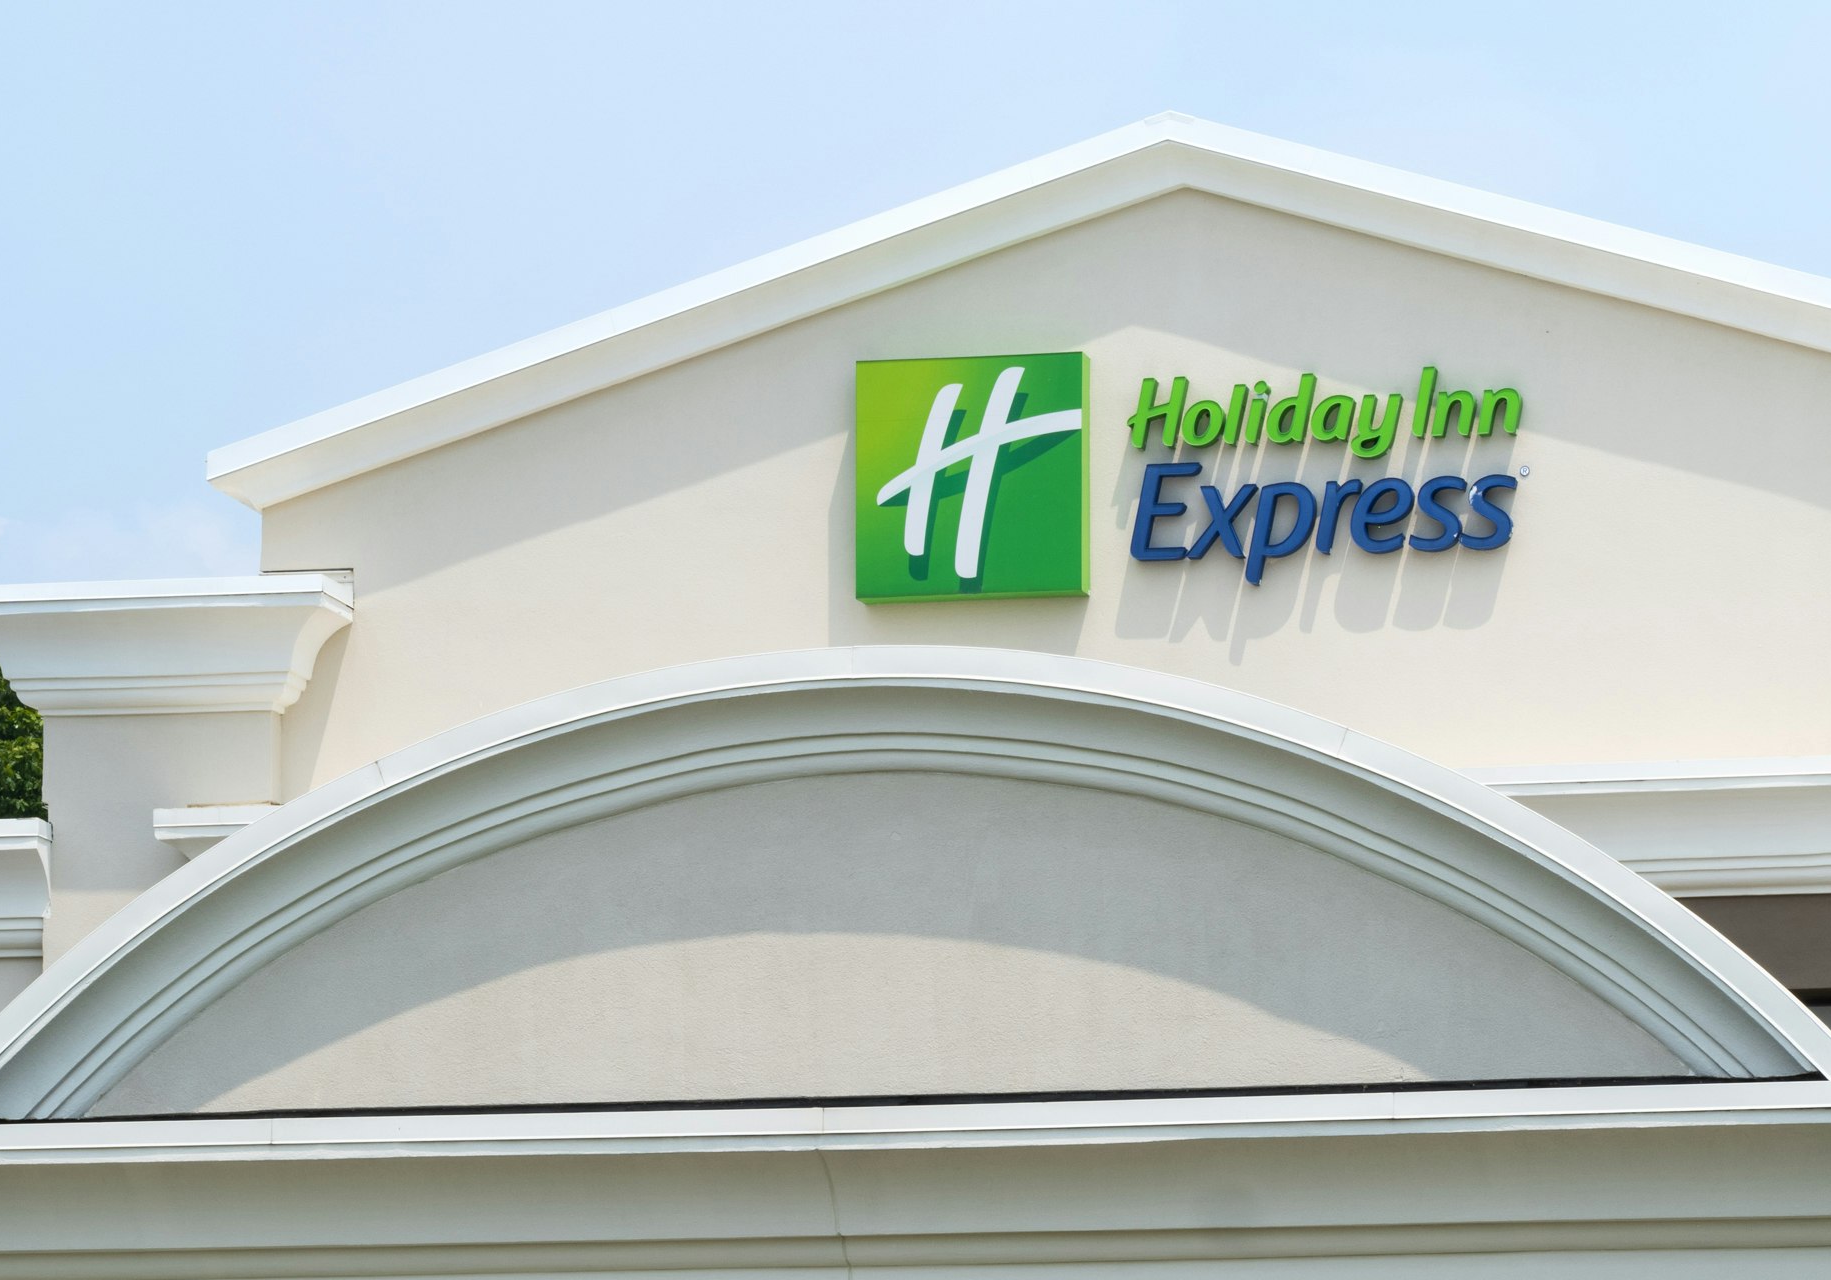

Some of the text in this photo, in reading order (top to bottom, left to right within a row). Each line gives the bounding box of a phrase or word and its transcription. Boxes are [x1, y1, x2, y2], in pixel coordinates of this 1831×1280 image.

[1127, 365, 1522, 460] Holiday Inn
[1129, 461, 1519, 587] Express
